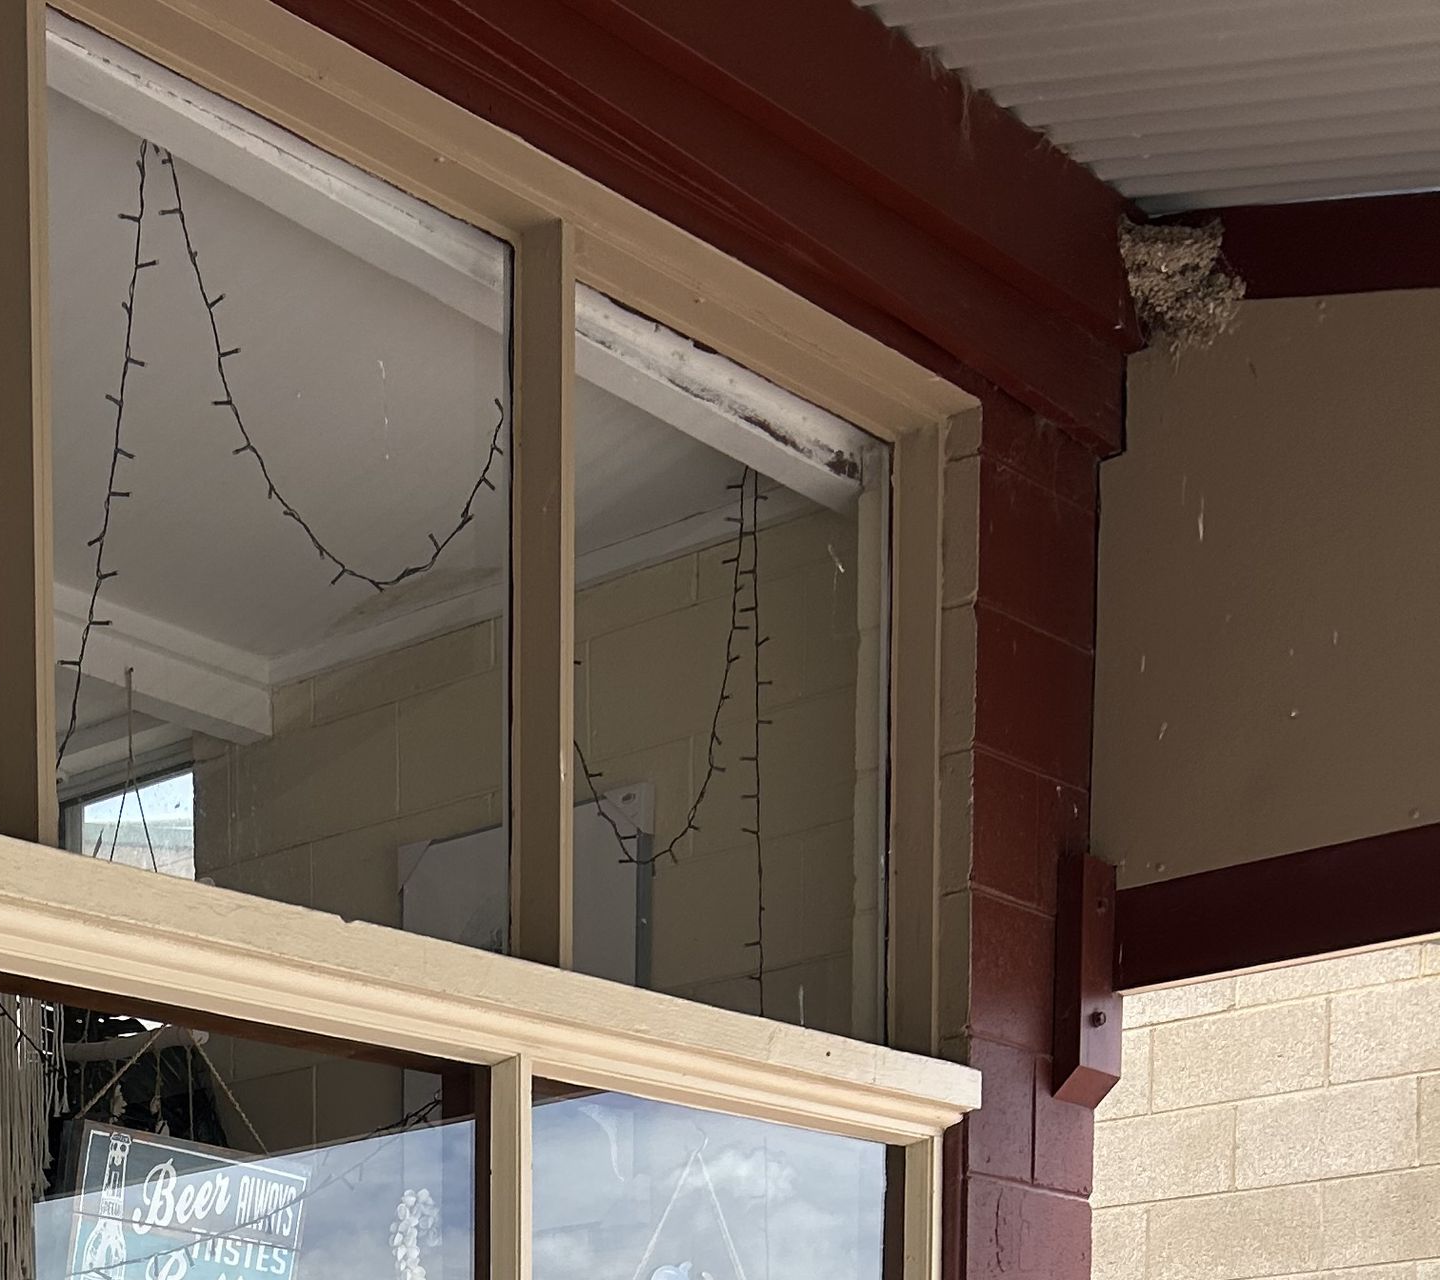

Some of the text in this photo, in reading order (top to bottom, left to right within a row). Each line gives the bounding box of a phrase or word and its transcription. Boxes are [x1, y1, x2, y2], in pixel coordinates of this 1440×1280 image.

[132, 1157, 298, 1237] Beer ALWAYS
[191, 1228, 288, 1275] TASTES
